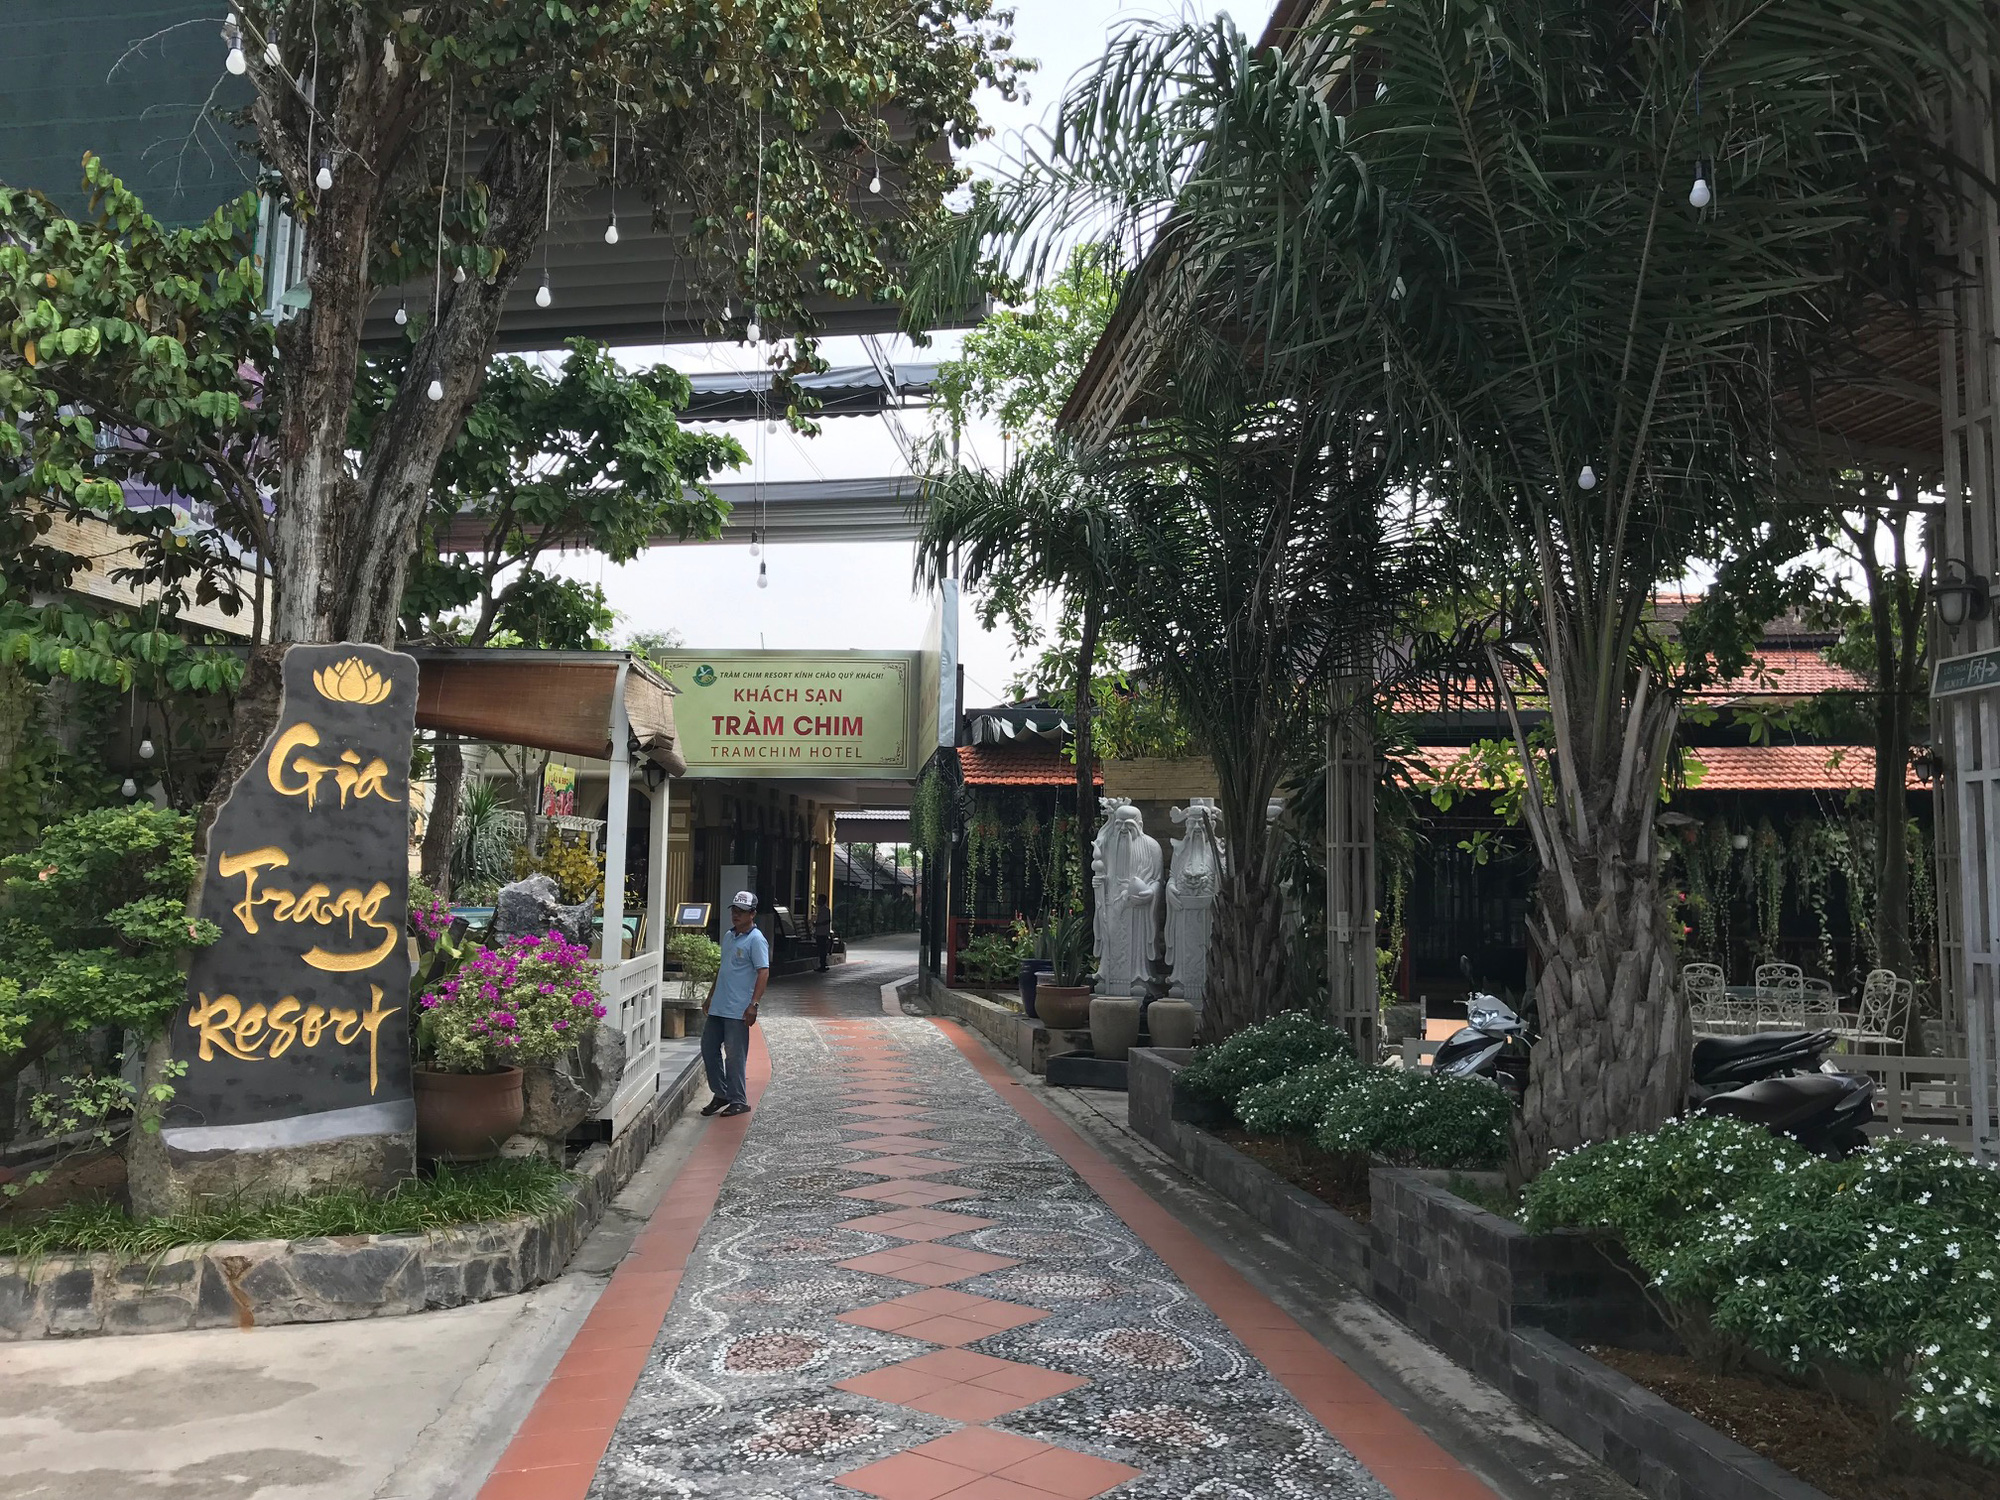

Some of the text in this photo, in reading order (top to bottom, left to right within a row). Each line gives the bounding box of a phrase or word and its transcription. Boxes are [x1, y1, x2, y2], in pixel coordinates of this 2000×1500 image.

[720, 670, 740, 678] TRÀM
[794, 670, 813, 679] KÍNH
[815, 670, 836, 679] CHÀO
[856, 671, 884, 679] KHÁCH!
[1943, 677, 1965, 690] EXIT
[733, 685, 842, 706] KHÁCH SẠN
[712, 709, 863, 736] TRÀM CHIM
[711, 746, 863, 758] TRAMCHIM HOTEL
[268, 721, 401, 812] Gia
[219, 845, 398, 972] Trang
[188, 984, 401, 1096] Resort
